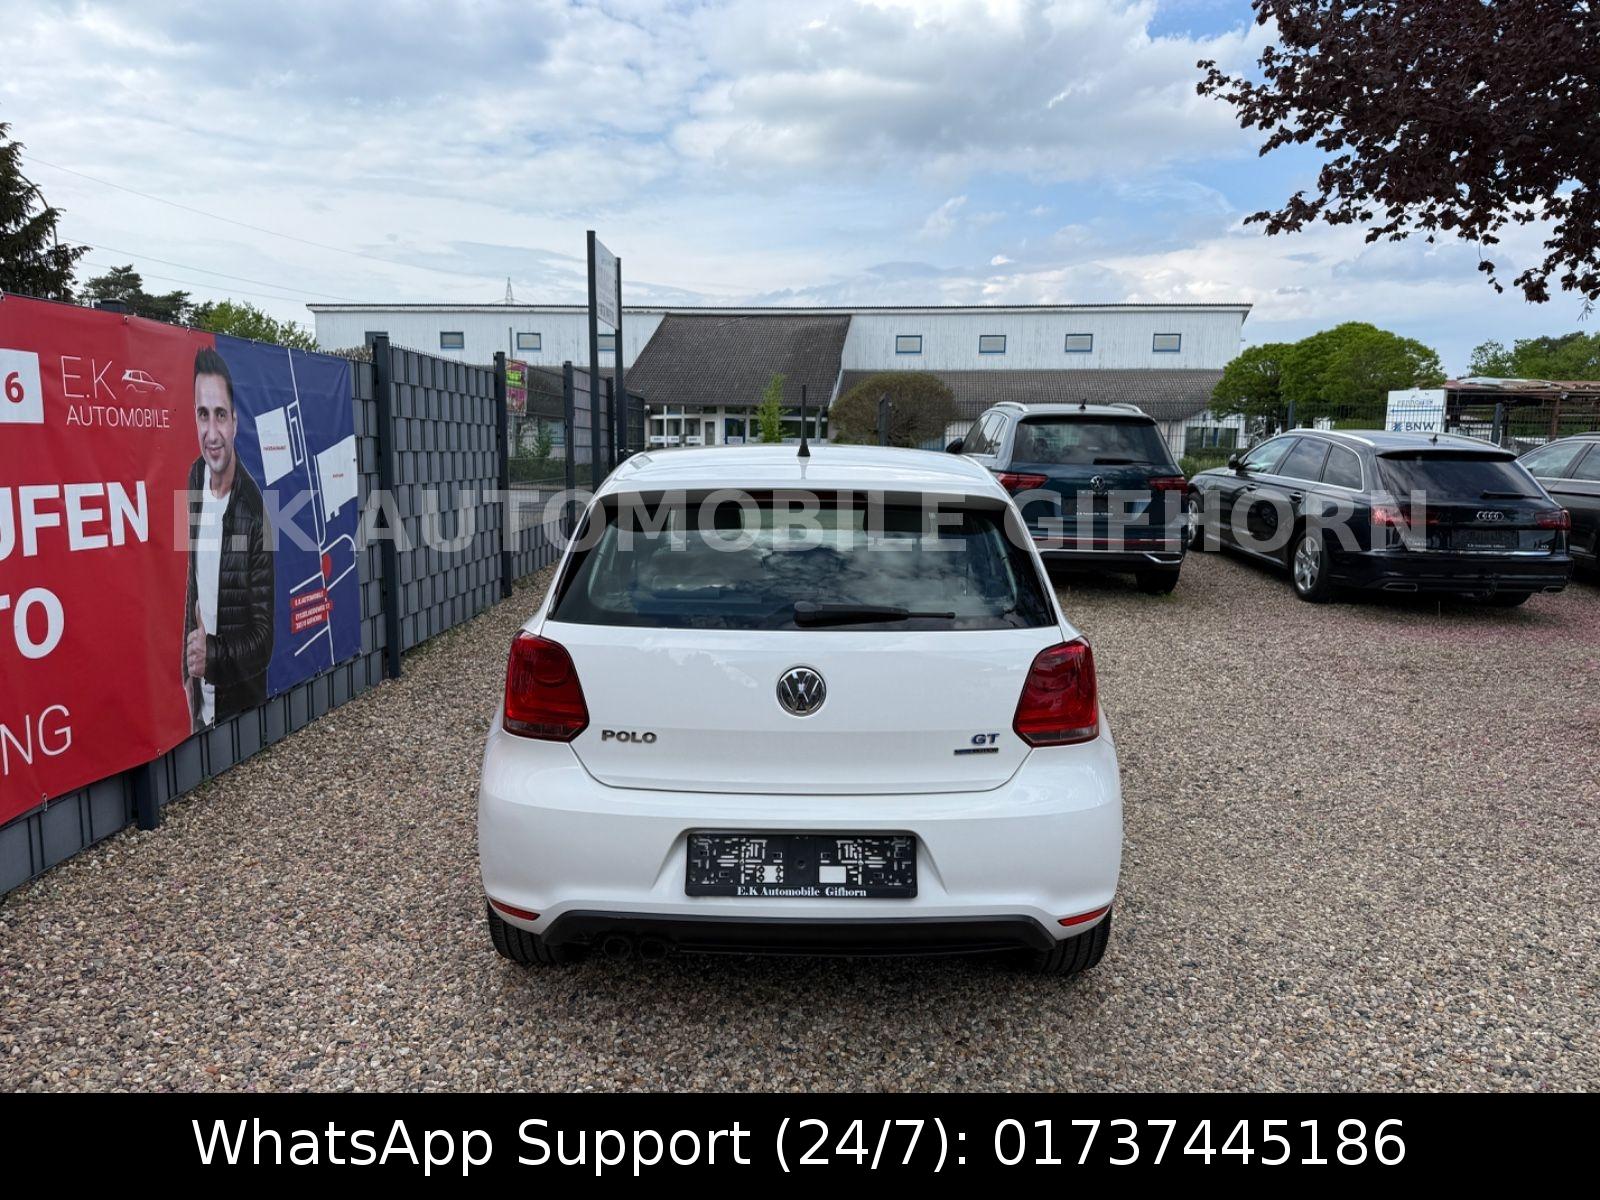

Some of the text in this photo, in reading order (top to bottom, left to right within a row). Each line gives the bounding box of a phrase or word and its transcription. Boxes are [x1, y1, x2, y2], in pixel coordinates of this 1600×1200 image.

[61, 355, 117, 400] E.K
[66, 404, 170, 429] AUTOMOBILE
[601, 729, 657, 744] POLO
[971, 733, 1000, 745] GT
[737, 885, 867, 897] E.K Automobile Gifhorn
